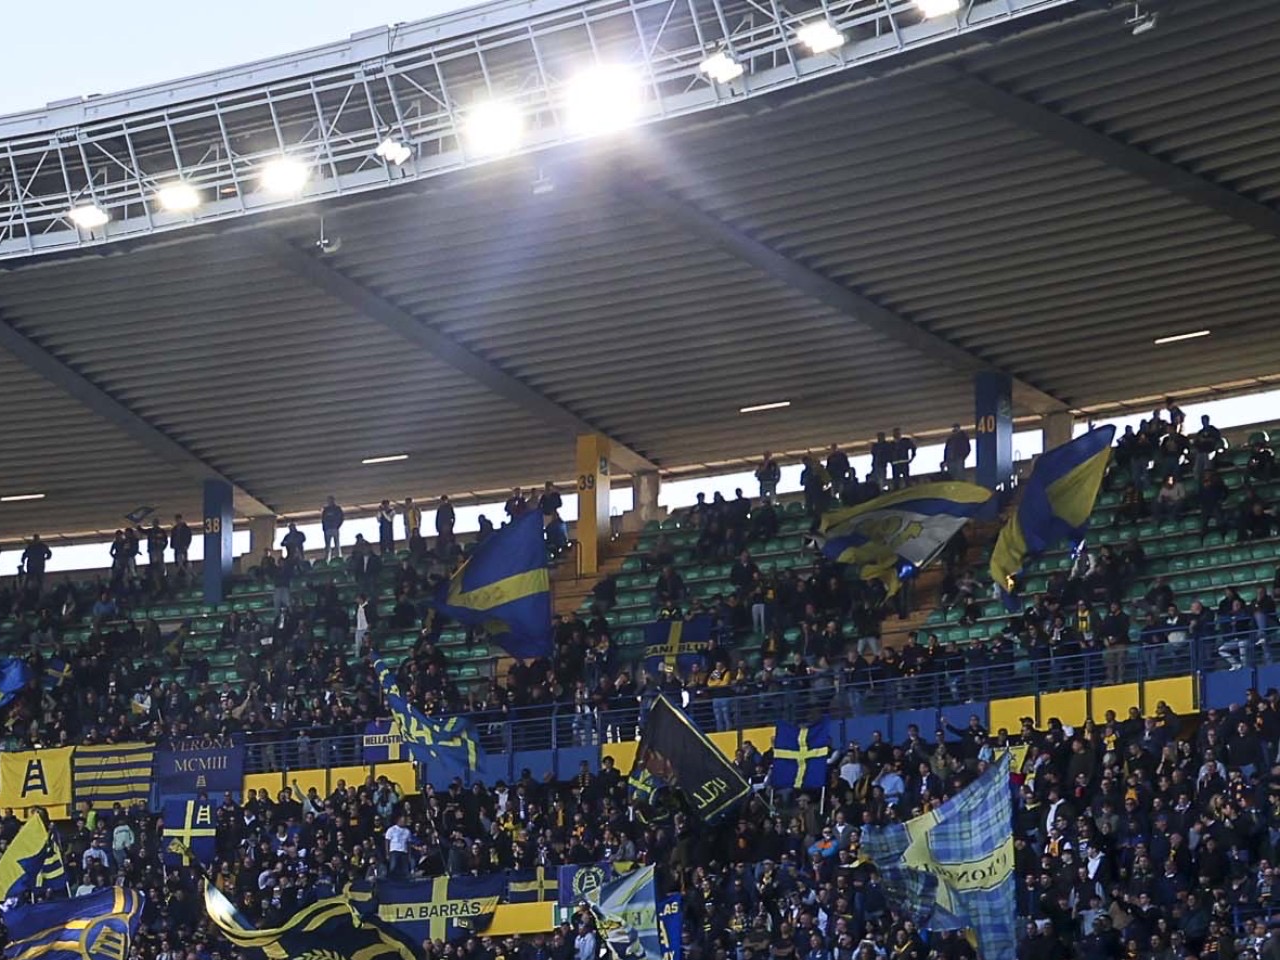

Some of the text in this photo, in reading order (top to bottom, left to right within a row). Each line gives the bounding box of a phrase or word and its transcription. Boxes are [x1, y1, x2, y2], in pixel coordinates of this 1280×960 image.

[978, 416, 996, 433] 40
[579, 474, 595, 491] 39
[204, 519, 219, 533] 38
[174, 756, 228, 773] MCMIII
[396, 907, 415, 920] LA
